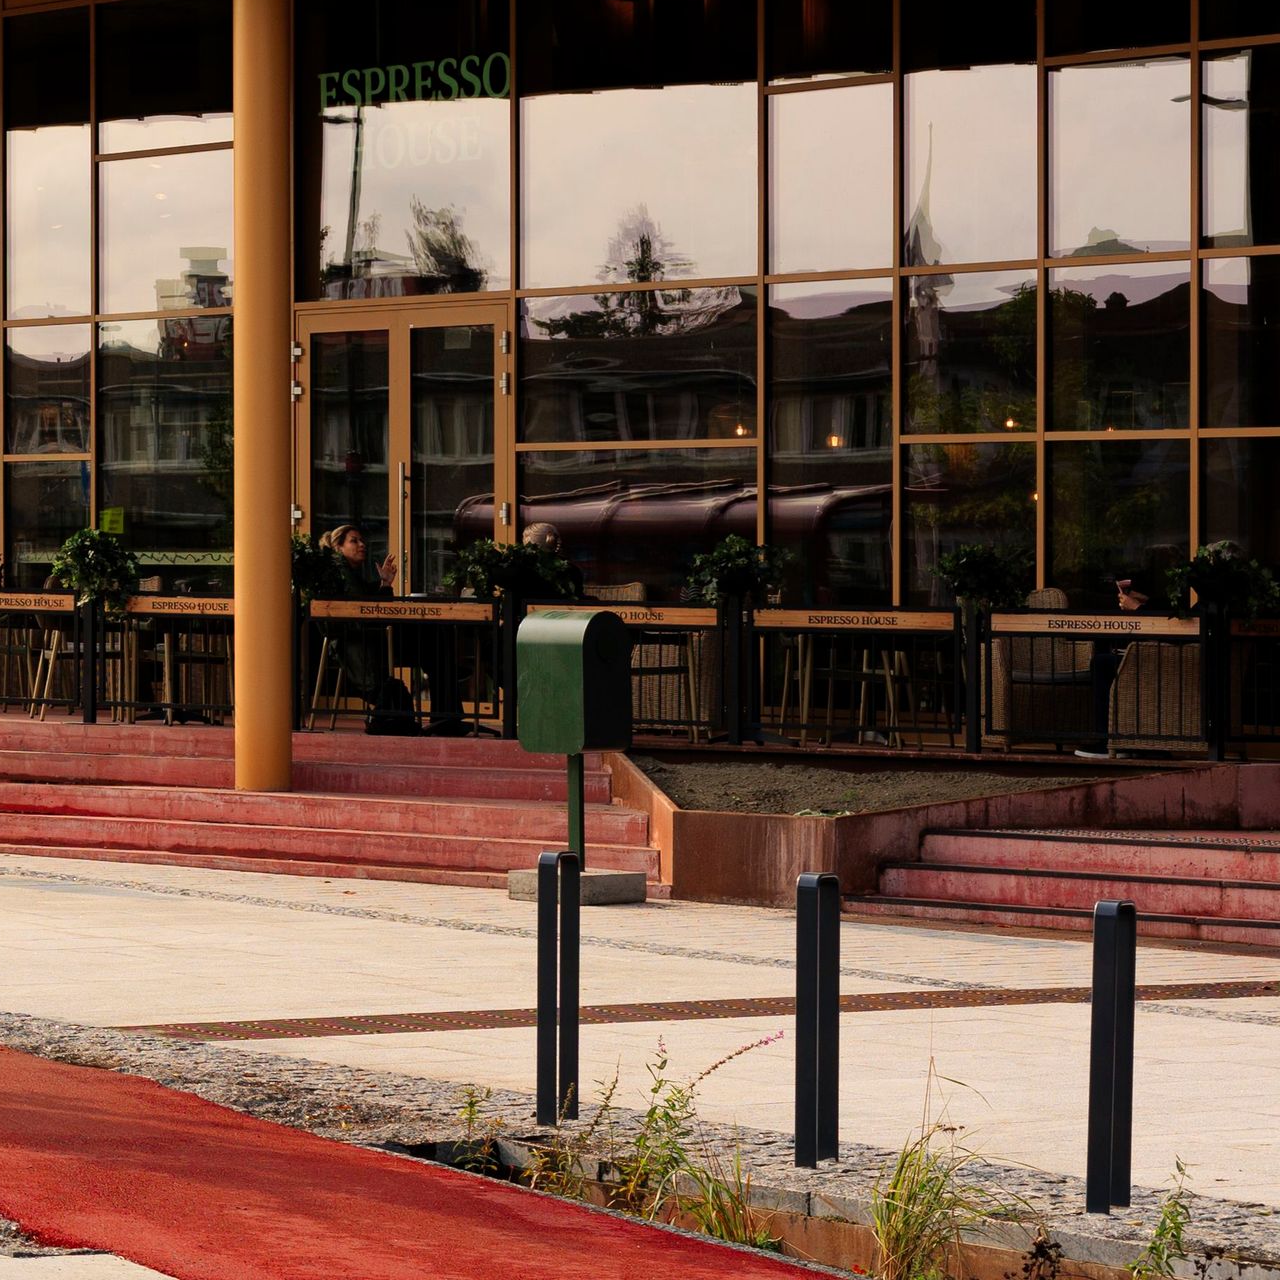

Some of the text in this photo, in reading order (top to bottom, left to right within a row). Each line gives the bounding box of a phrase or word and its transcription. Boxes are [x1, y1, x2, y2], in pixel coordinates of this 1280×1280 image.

[318, 52, 510, 116] ESPRESSO
[33, 598, 65, 608] HOUSE
[152, 601, 229, 611] ESPRESSO HOUSE
[360, 606, 442, 616] ESPRESSO HOUSE
[630, 611, 664, 620] HOUSE
[808, 615, 898, 625] ESPRESSO HOUSE
[1048, 619, 1141, 630] ESPRESSO HOUSE
